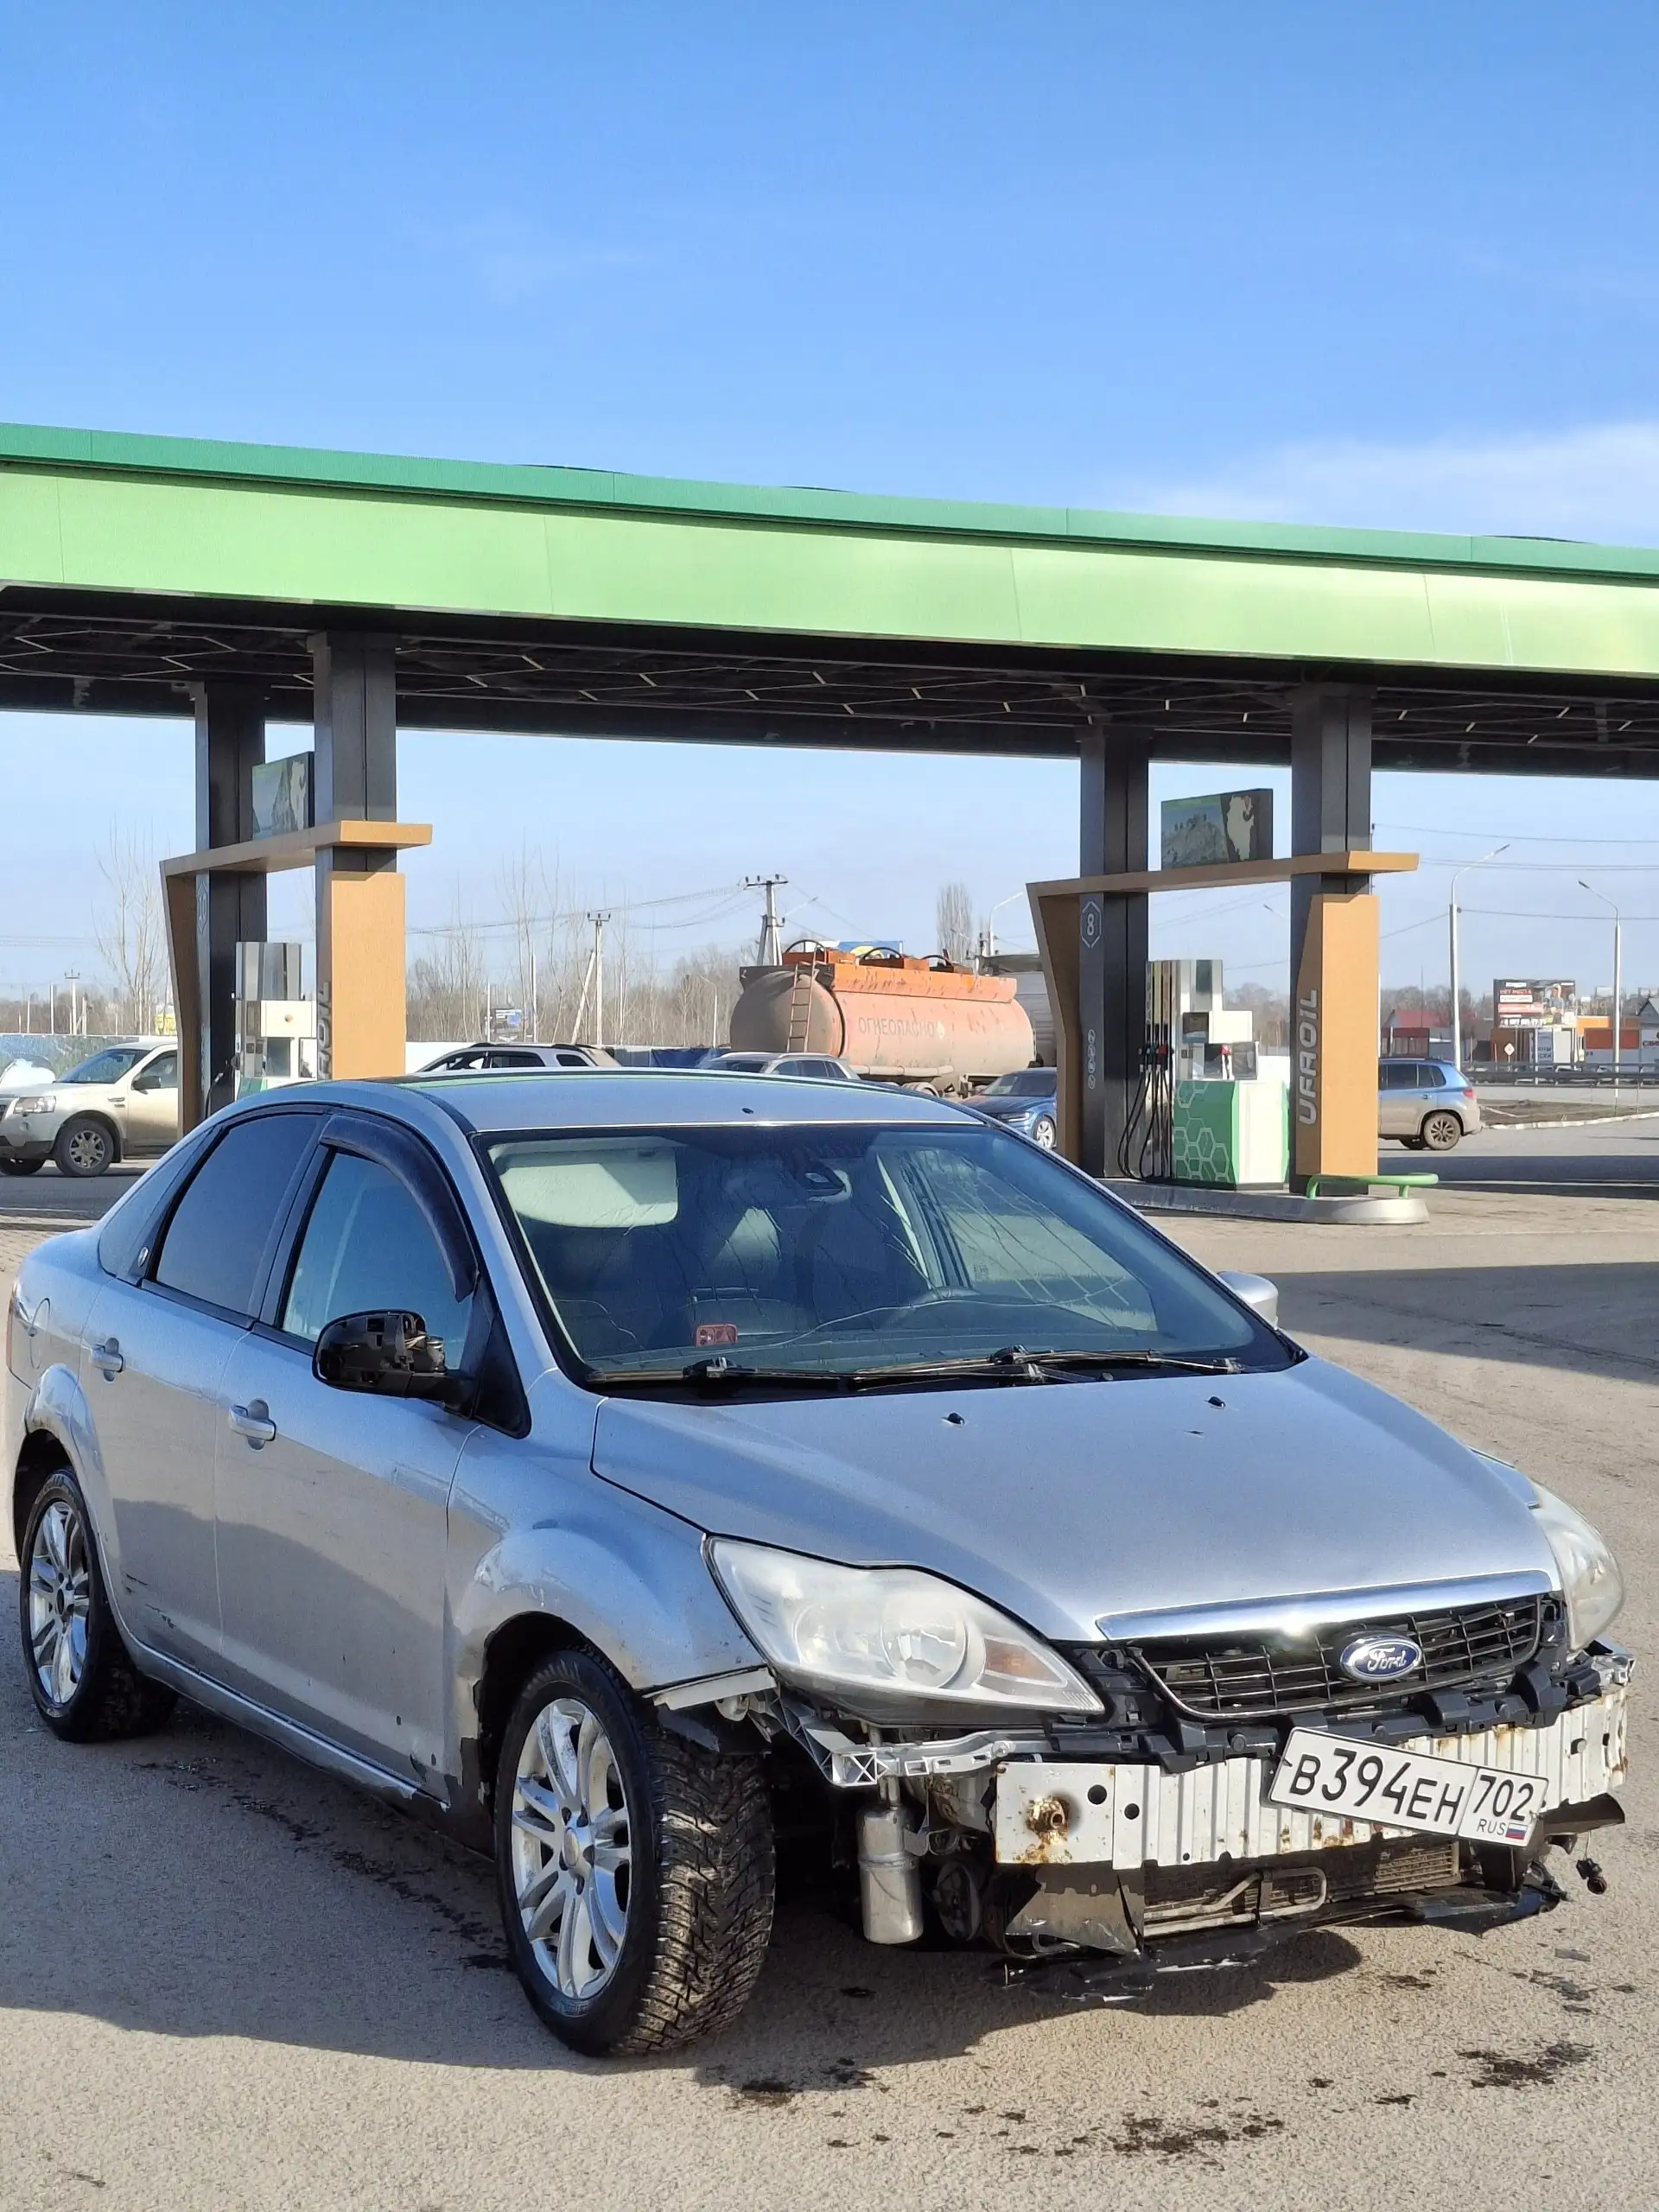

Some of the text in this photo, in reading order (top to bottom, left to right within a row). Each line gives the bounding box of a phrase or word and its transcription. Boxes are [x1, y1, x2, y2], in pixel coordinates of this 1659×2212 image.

[1086, 912, 1096, 937] 8
[858, 1016, 936, 1038] ОГНЕОПАСНО
[1367, 1646, 1408, 1673] Ford
[1472, 1775, 1535, 1823] 702
[1476, 1818, 1506, 1836] RUS
